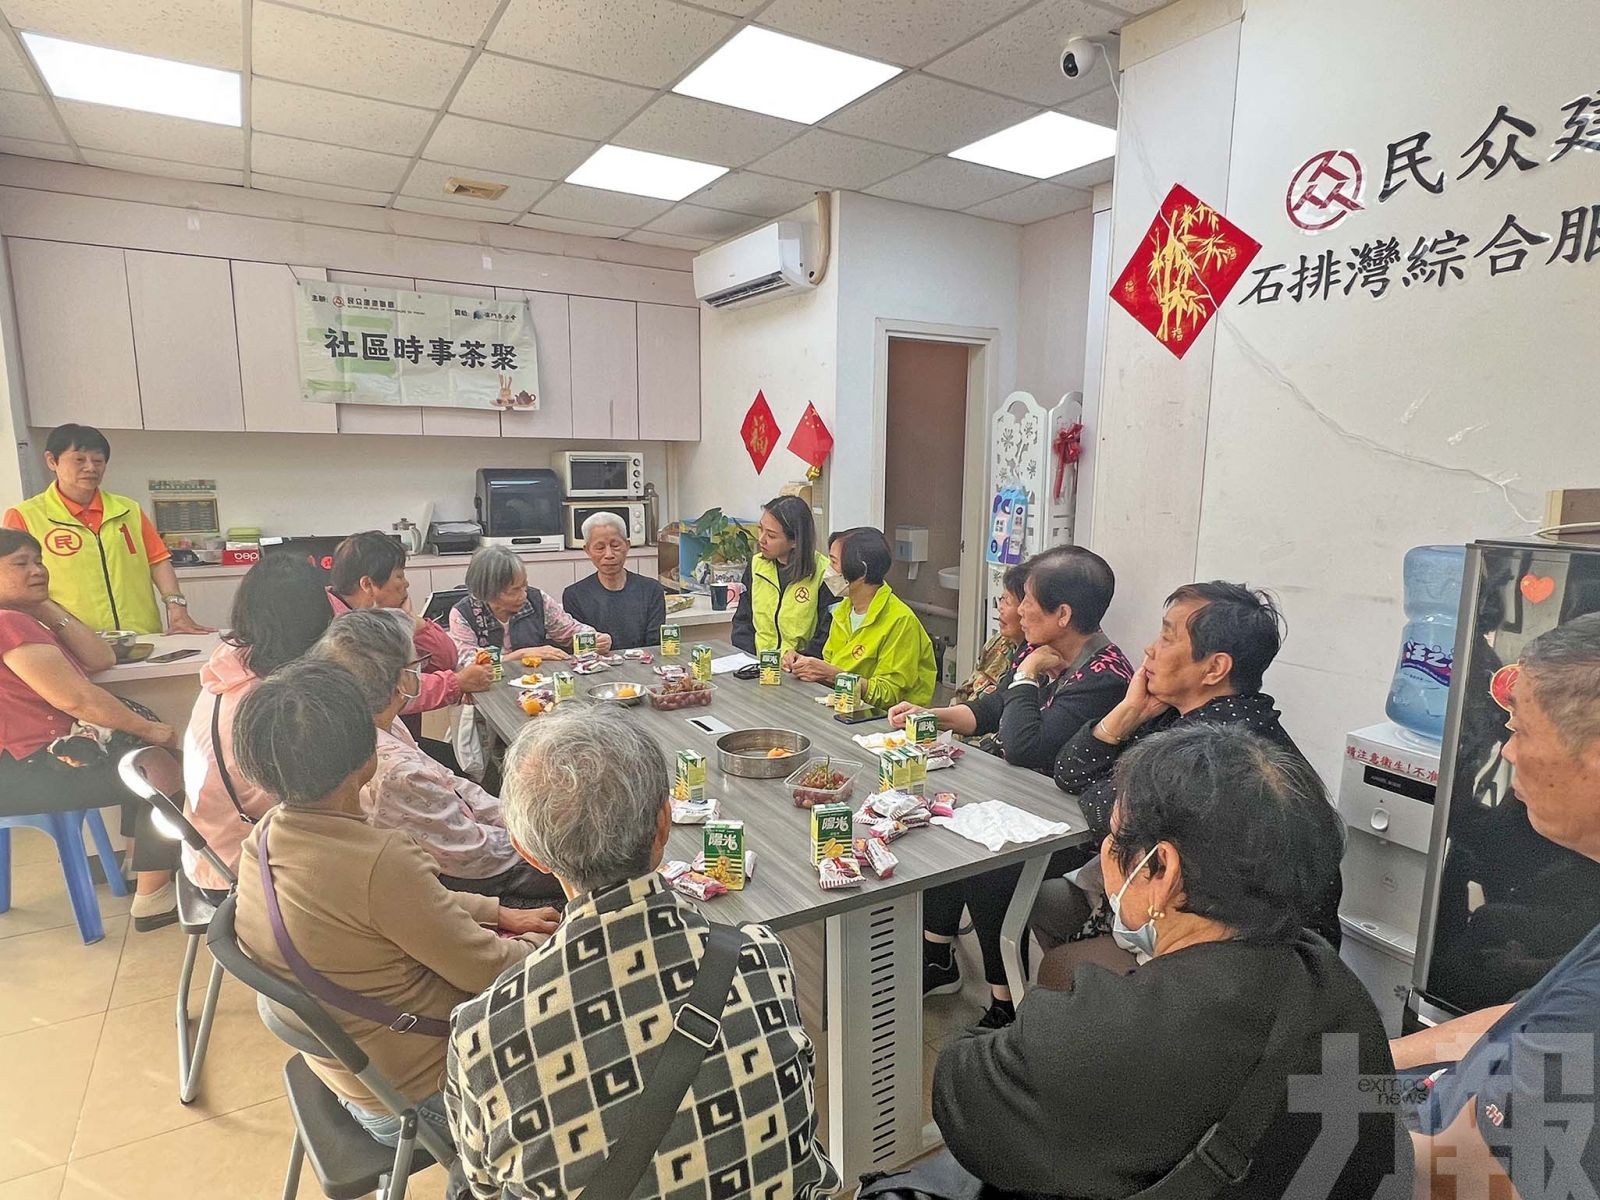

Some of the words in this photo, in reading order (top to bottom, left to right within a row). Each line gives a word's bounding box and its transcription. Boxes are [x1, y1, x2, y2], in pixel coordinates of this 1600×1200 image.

[1238, 204, 1600, 305] 石排灣綜合服
[324, 328, 518, 371] 社區時事茶聚
[119, 523, 137, 554] 1
